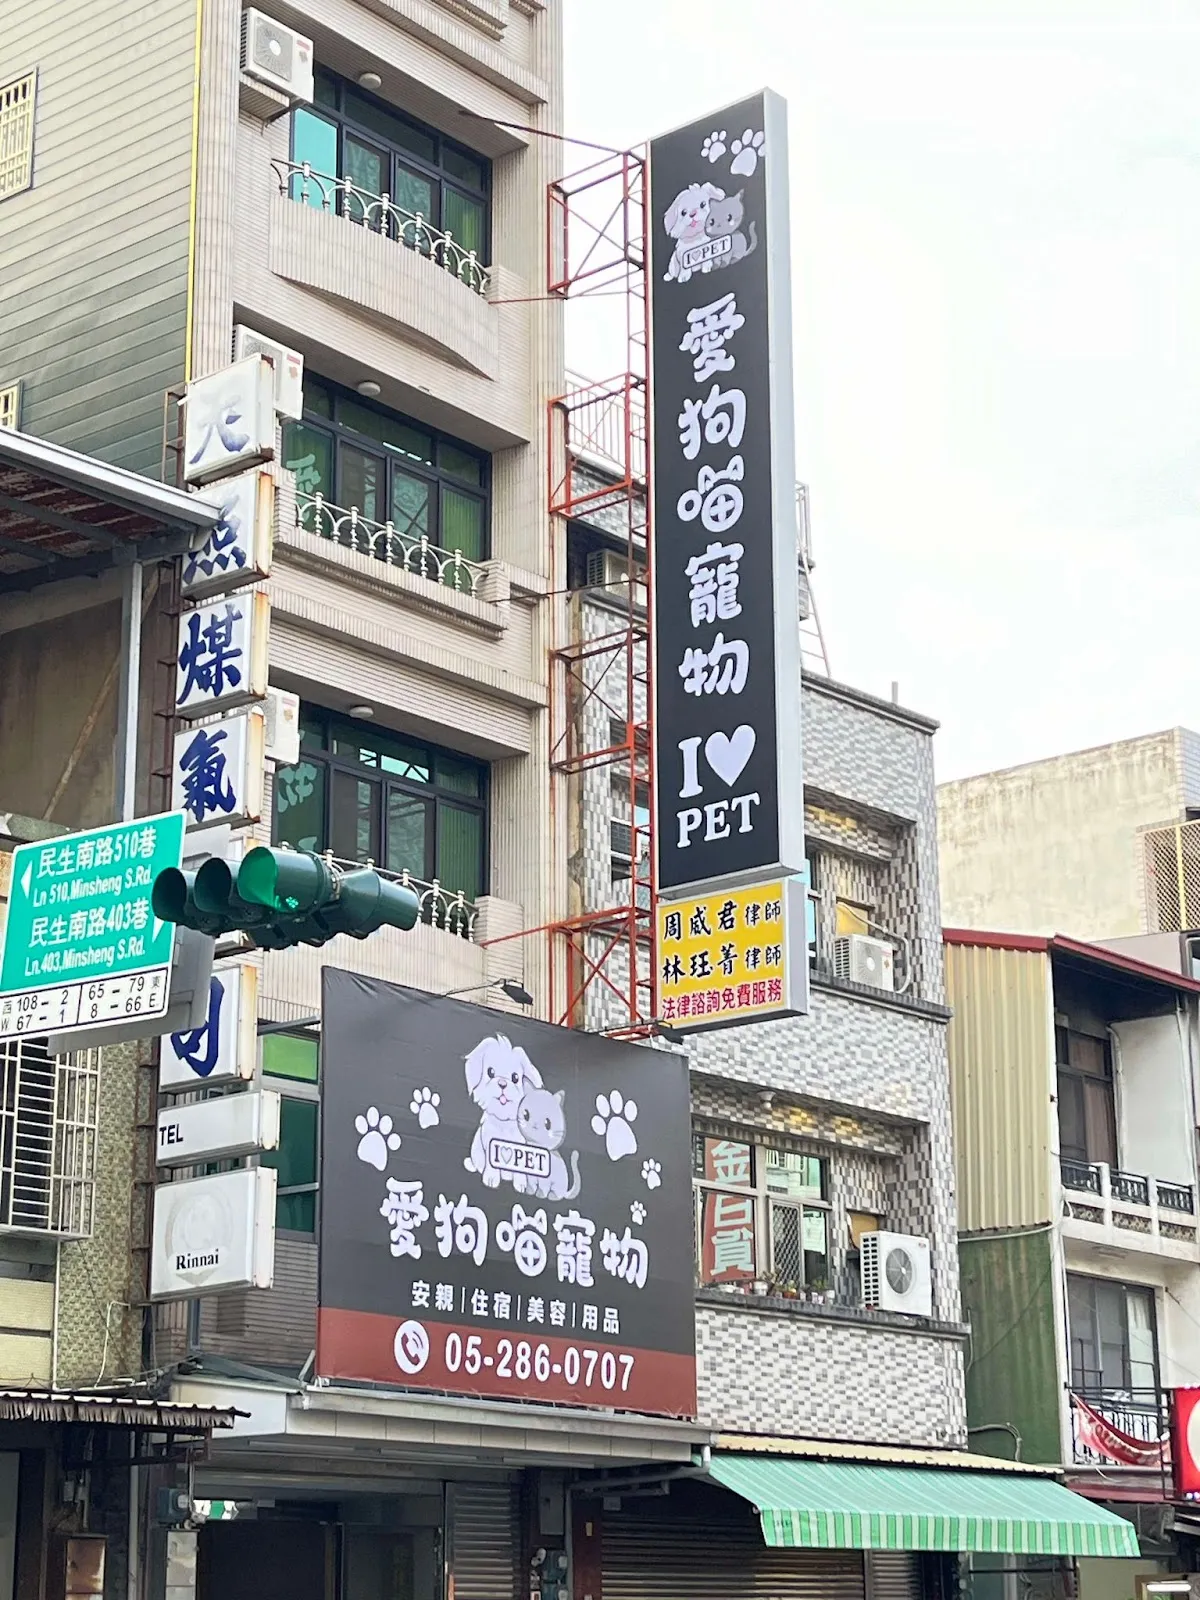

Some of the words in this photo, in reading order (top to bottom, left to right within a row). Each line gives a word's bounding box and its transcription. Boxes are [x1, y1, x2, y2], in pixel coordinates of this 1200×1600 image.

[702, 238, 728, 259] PET
[676, 291, 750, 697] 愛狗喵寵物
[677, 736, 704, 799] I
[676, 792, 761, 849] PET
[36, 825, 158, 880] 民生南路510巷
[124, 863, 154, 889] S.Rd.
[28, 896, 150, 948] 民生南路403巷
[116, 935, 146, 961] S.Rd.
[661, 978, 783, 1021] 法律諮詢免費服務
[159, 1123, 184, 1147] TEL
[513, 1148, 546, 1172] PET
[379, 1176, 649, 1290] 愛狗喵寵物
[175, 1248, 220, 1271] Rinnai
[444, 1331, 636, 1392] 05-286-0707
